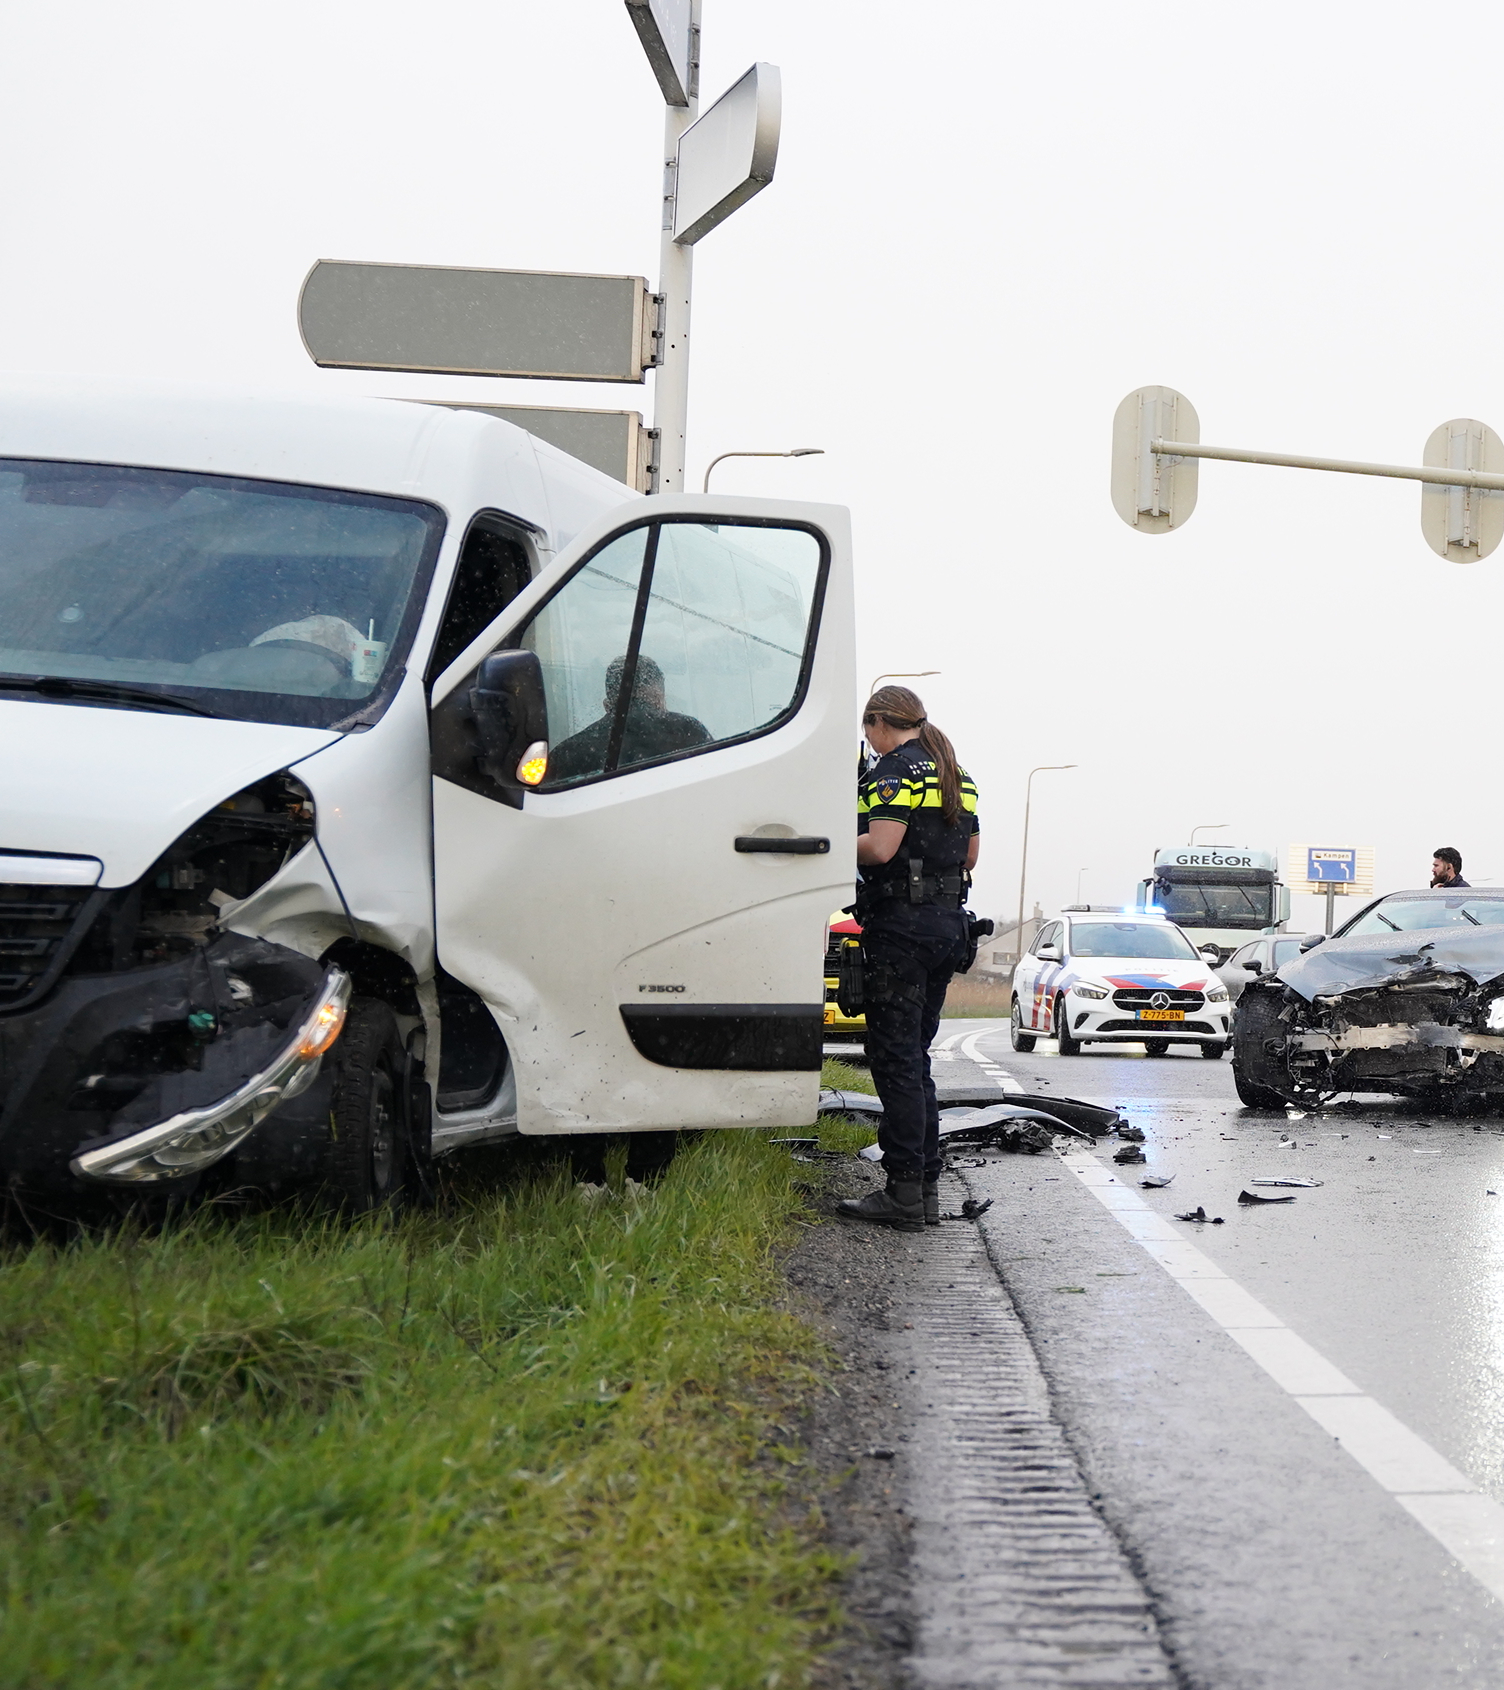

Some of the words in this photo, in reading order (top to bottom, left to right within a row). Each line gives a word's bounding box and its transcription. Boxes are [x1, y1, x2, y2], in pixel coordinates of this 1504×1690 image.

[1176, 854, 1251, 867] GREGOR
[1323, 852, 1350, 860] Kampen
[1143, 1011, 1181, 1020] Z-775-BN
